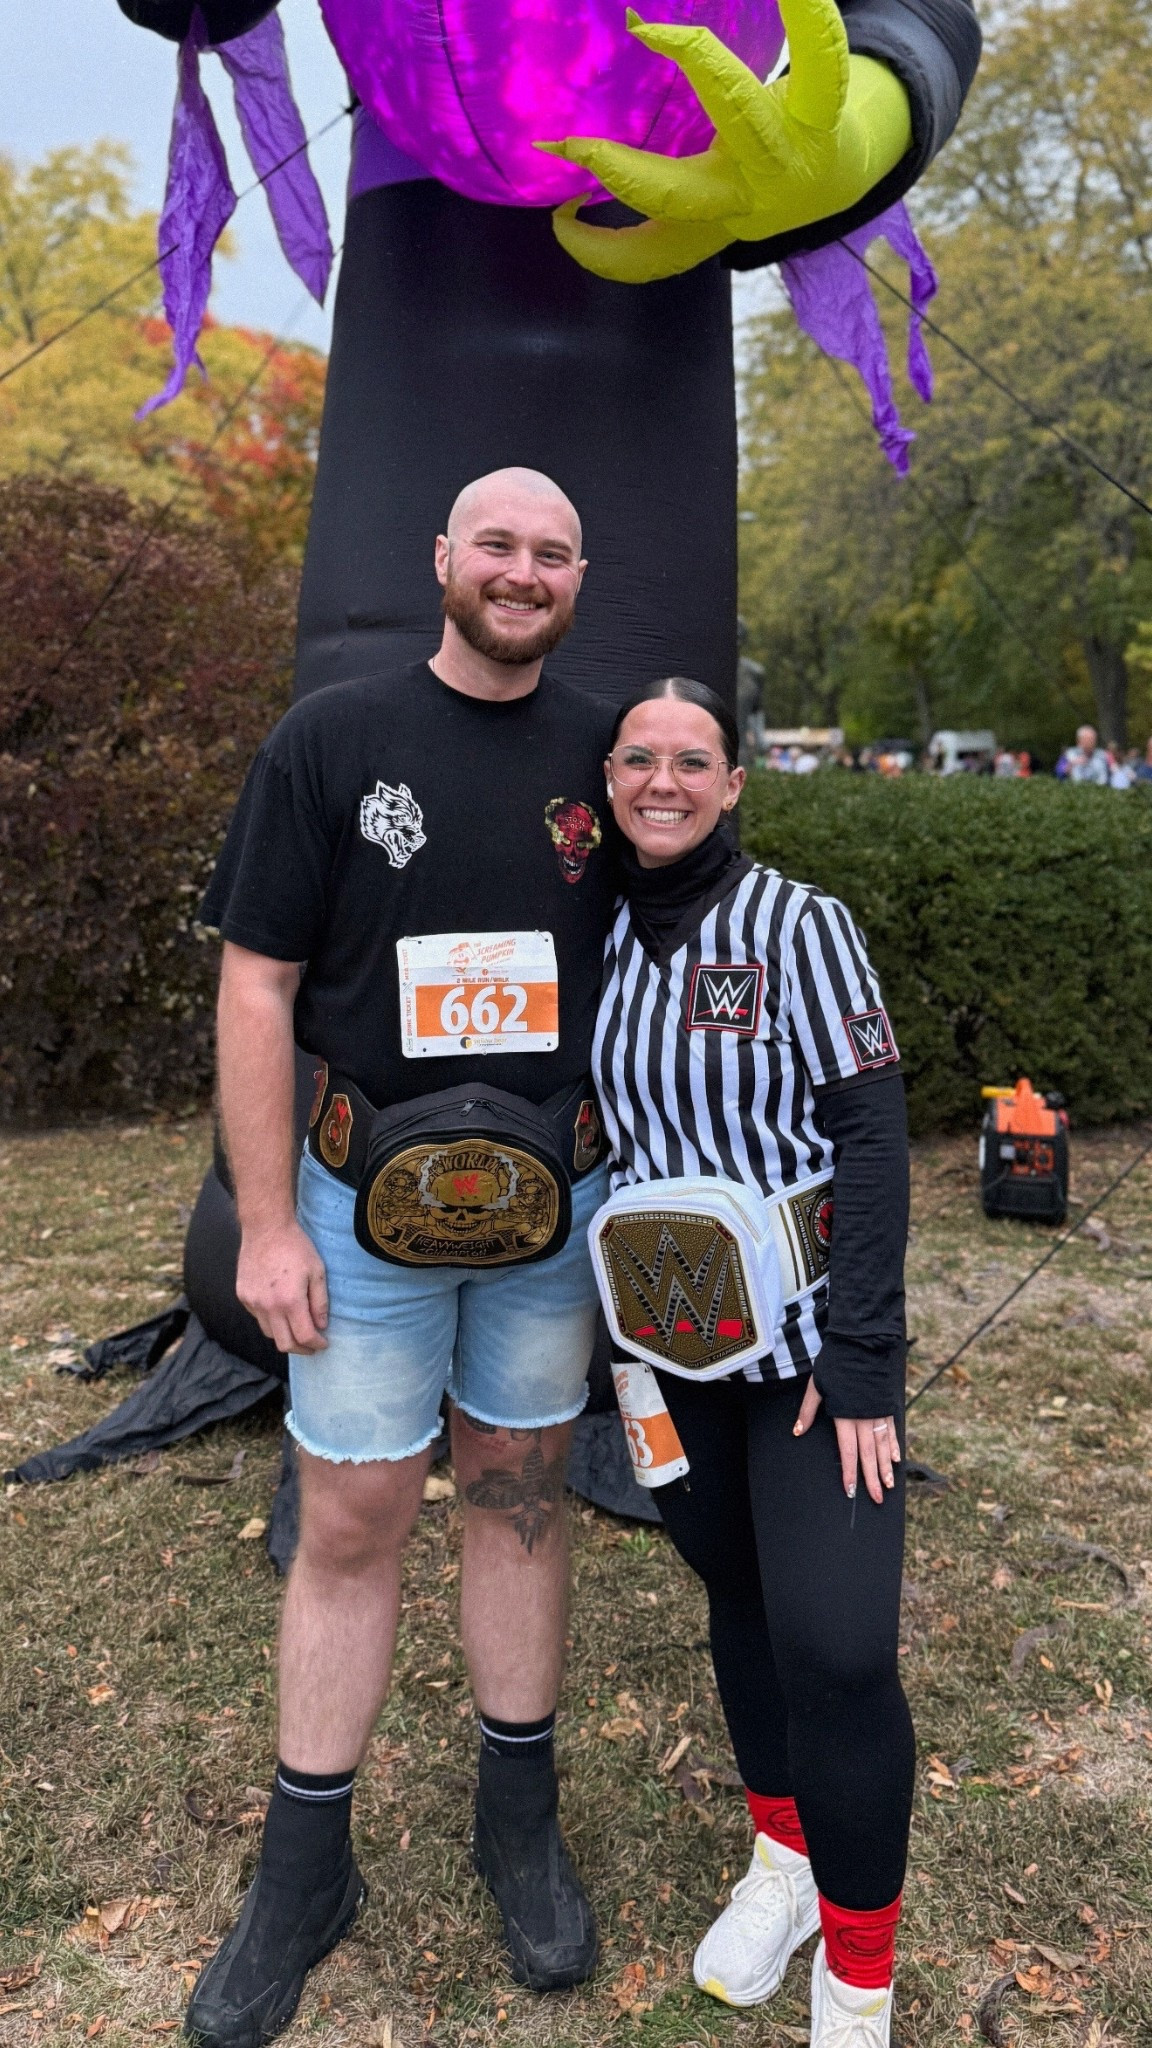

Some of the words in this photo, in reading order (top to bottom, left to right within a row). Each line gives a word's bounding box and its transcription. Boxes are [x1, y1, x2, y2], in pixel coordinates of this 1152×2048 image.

[477, 938, 517, 955] SCREAMING
[481, 948, 515, 964] PUMPKIN
[440, 984, 529, 1035] 662
[440, 1152, 498, 1173] WORLD
[415, 1235, 495, 1251] HEAVYWEIGHT
[424, 1247, 488, 1257] CHAMPION
[712, 1340, 748, 1360] CHAMPION
